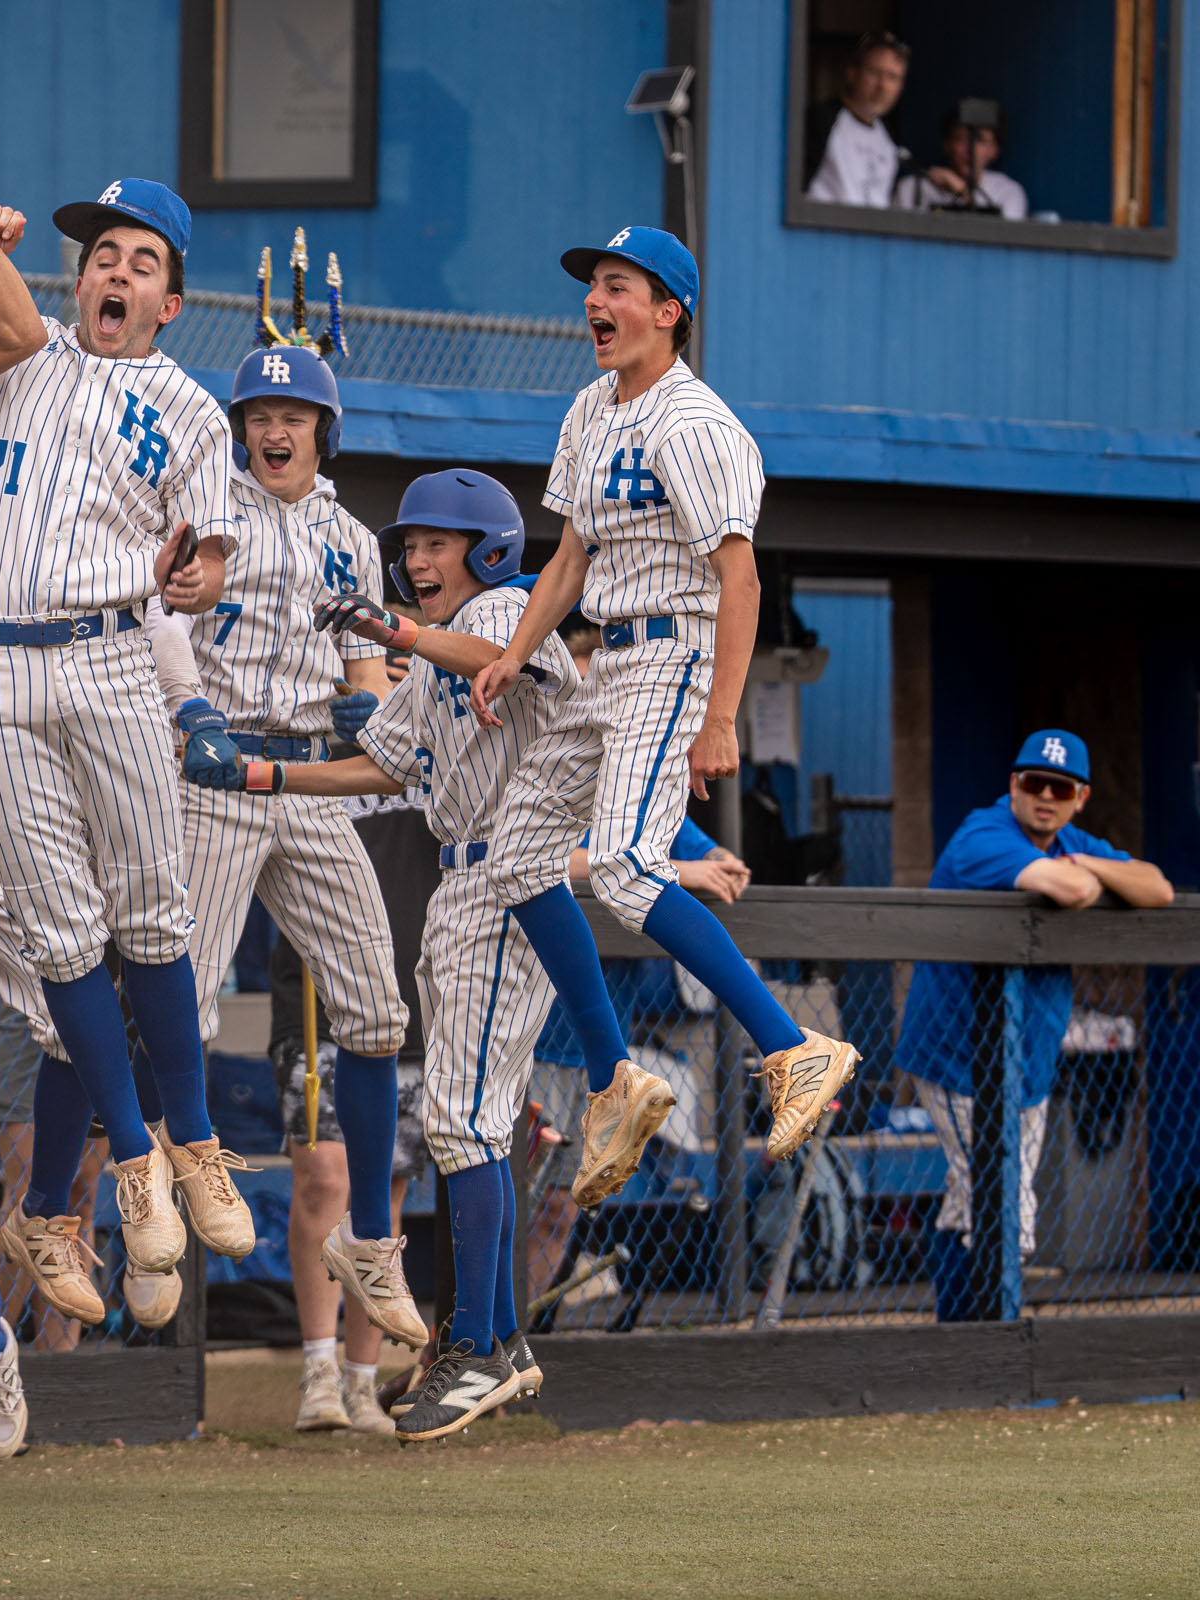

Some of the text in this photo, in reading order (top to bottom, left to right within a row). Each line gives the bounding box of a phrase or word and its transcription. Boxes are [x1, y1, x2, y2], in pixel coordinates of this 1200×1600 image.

[261, 354, 291, 384] HR
[117, 389, 170, 491] HR
[604, 447, 672, 511] HR
[213, 602, 243, 646] 7
[1041, 737, 1067, 767] HR
